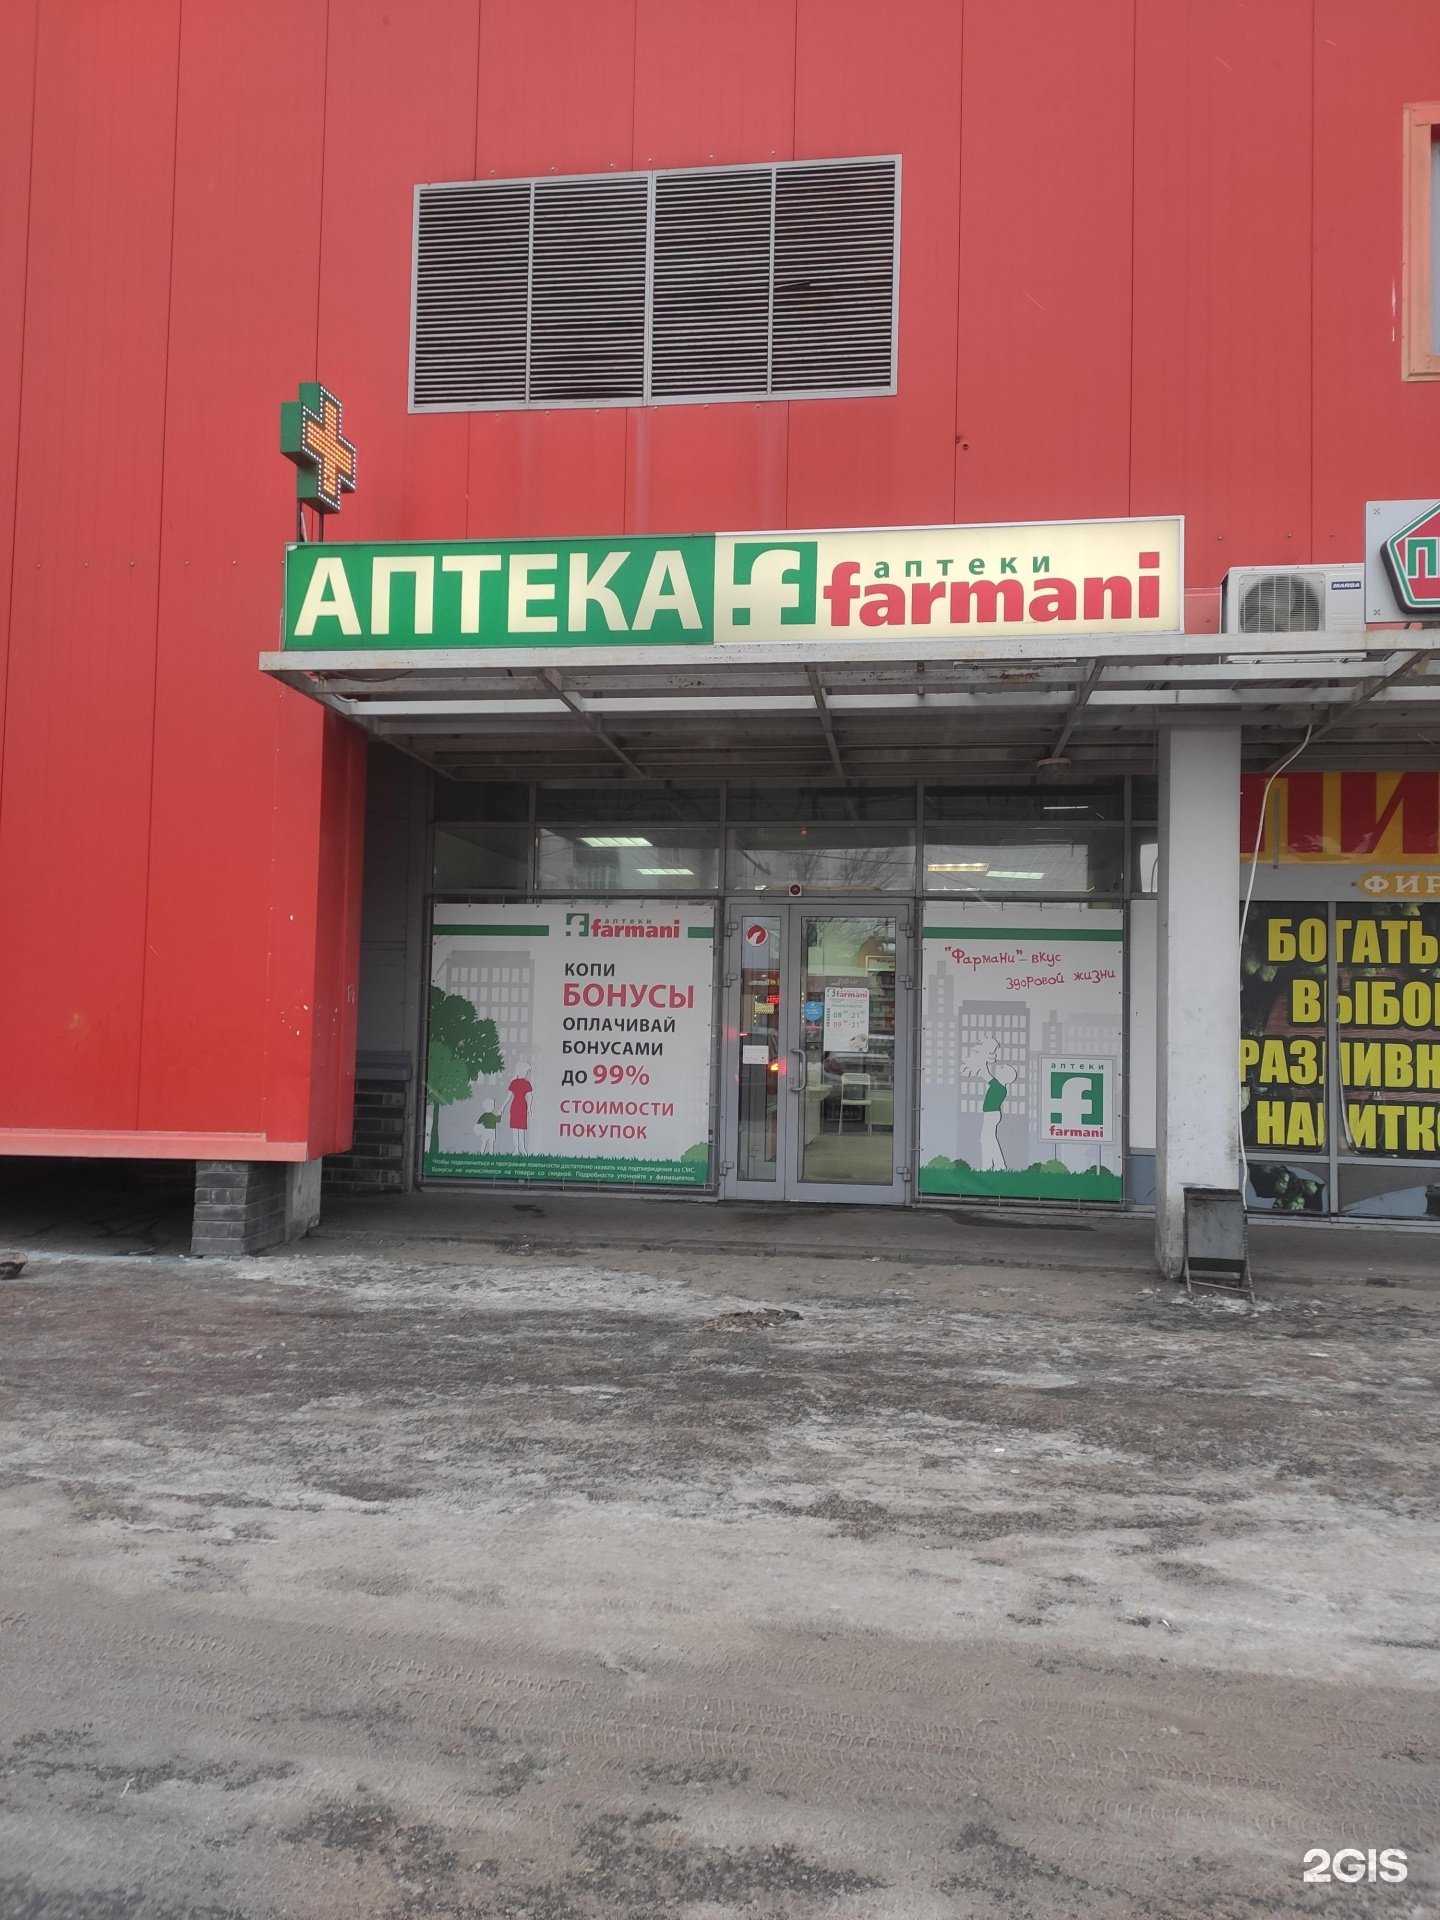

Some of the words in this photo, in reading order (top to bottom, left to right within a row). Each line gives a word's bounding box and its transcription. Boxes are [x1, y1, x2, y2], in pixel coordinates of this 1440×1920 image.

[874, 555, 1050, 579] аптеки
[294, 550, 703, 636] АПТЕКА
[823, 551, 1160, 627] farmani
[591, 918, 680, 938] farmani
[564, 963, 615, 977] КОПИ
[1073, 968, 1116, 984] жизни
[563, 983, 695, 1009] БОНУСЫ
[1292, 979, 1440, 1028] ВЫБО
[562, 1016, 676, 1033] ОПЛАЧИВАЙ
[562, 1040, 663, 1056] БОНУСАМИ
[1051, 1062, 1104, 1070] аптеки
[561, 1069, 587, 1087] ДО
[592, 1064, 650, 1086] 99%
[560, 1099, 674, 1117] СТОИМОСТИ
[559, 1123, 647, 1140] ПОКУПОК
[1049, 1125, 1104, 1139] farmani
